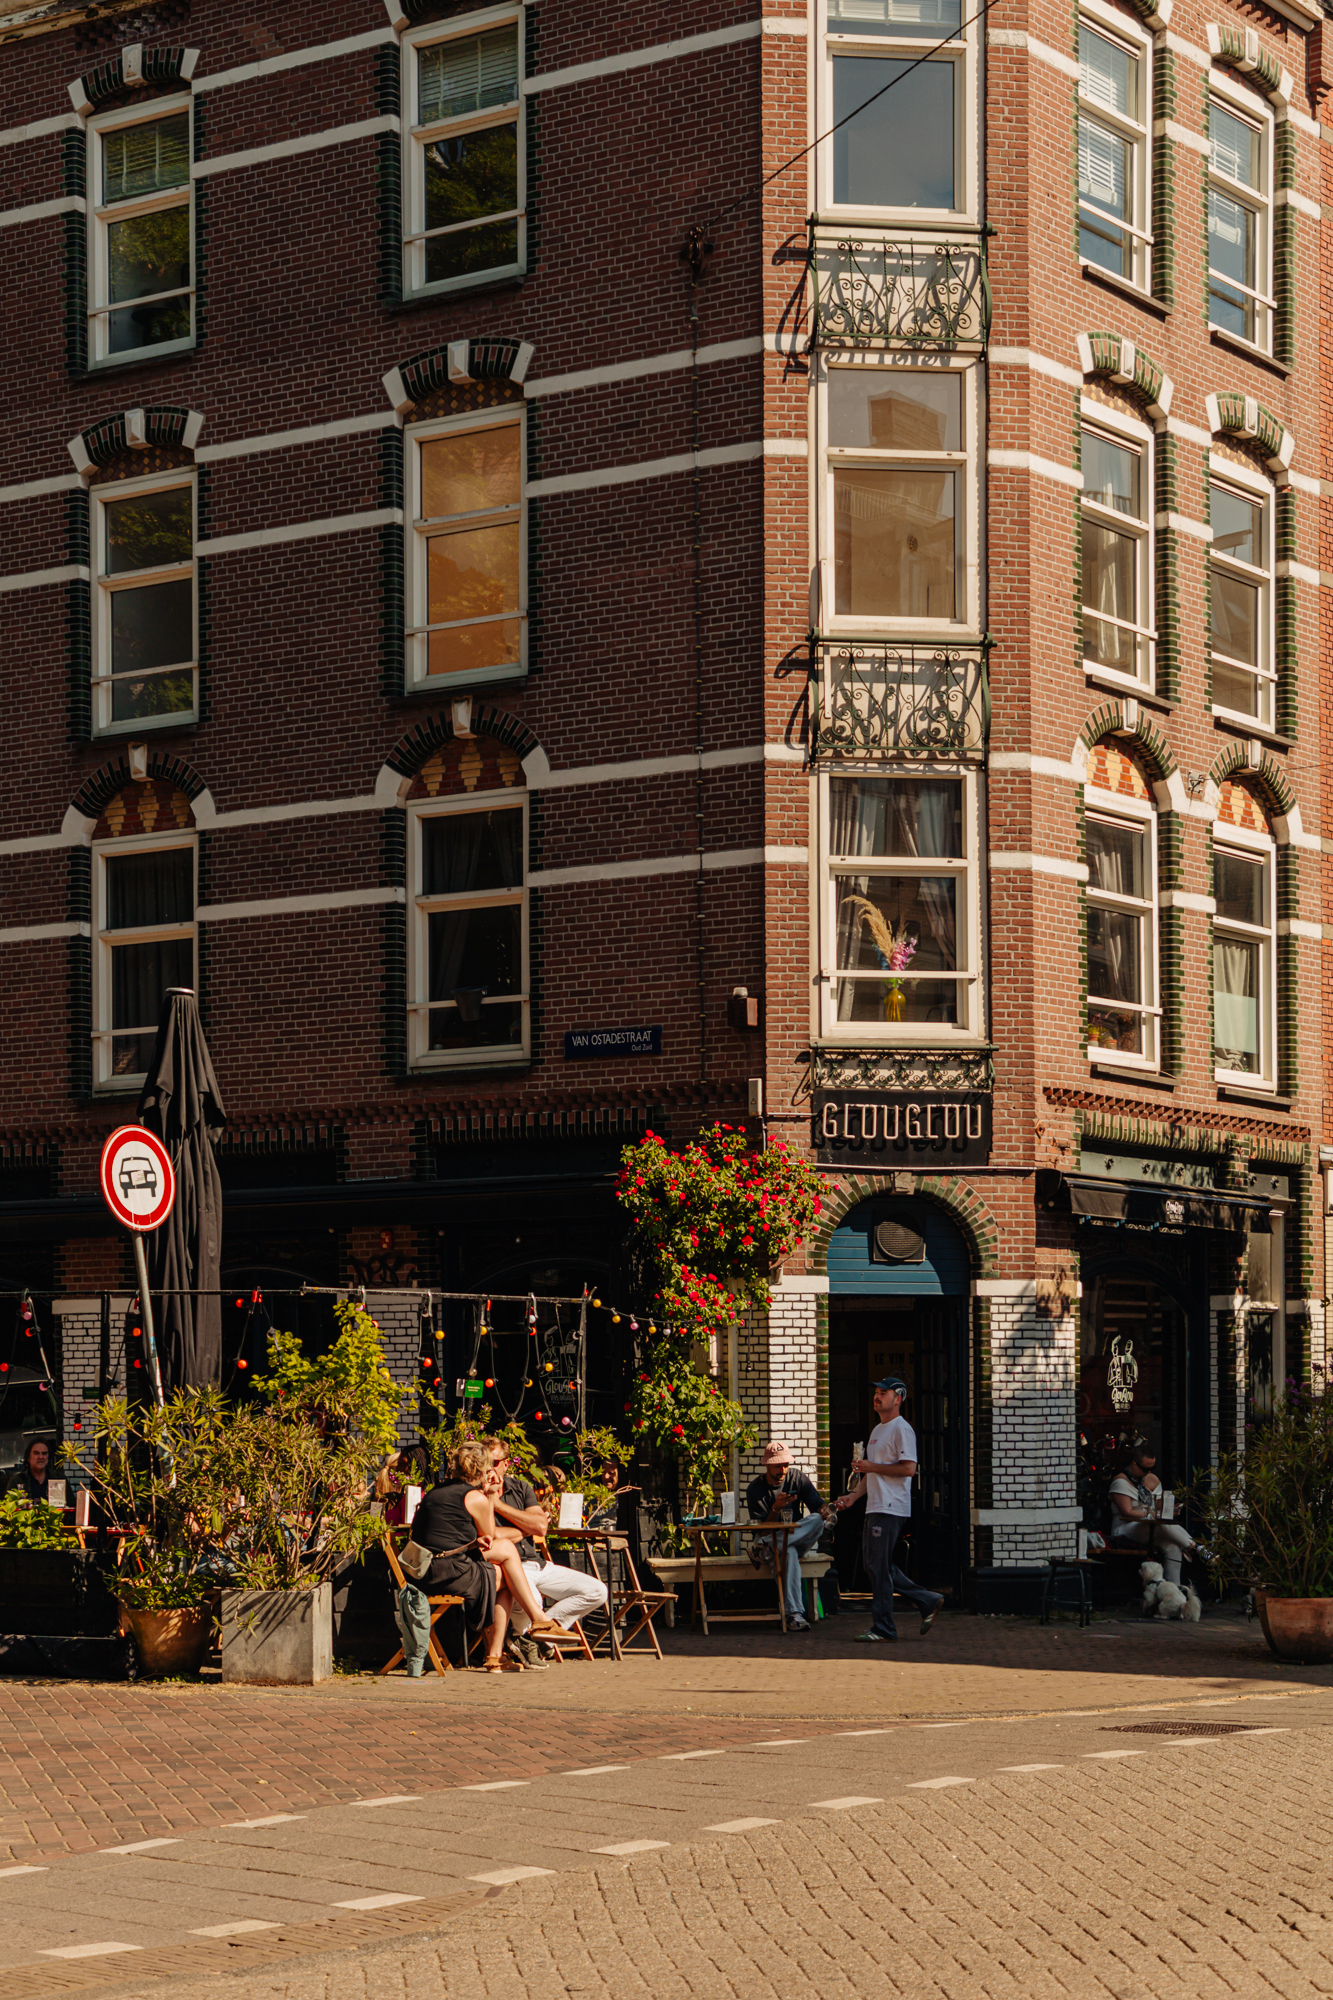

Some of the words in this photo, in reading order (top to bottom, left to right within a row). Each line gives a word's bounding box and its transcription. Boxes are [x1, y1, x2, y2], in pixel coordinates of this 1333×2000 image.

[571, 1035, 589, 1046] VAN
[591, 1030, 652, 1046] OSTADESTRAAT
[822, 1102, 982, 1139] GLOUGLOU
